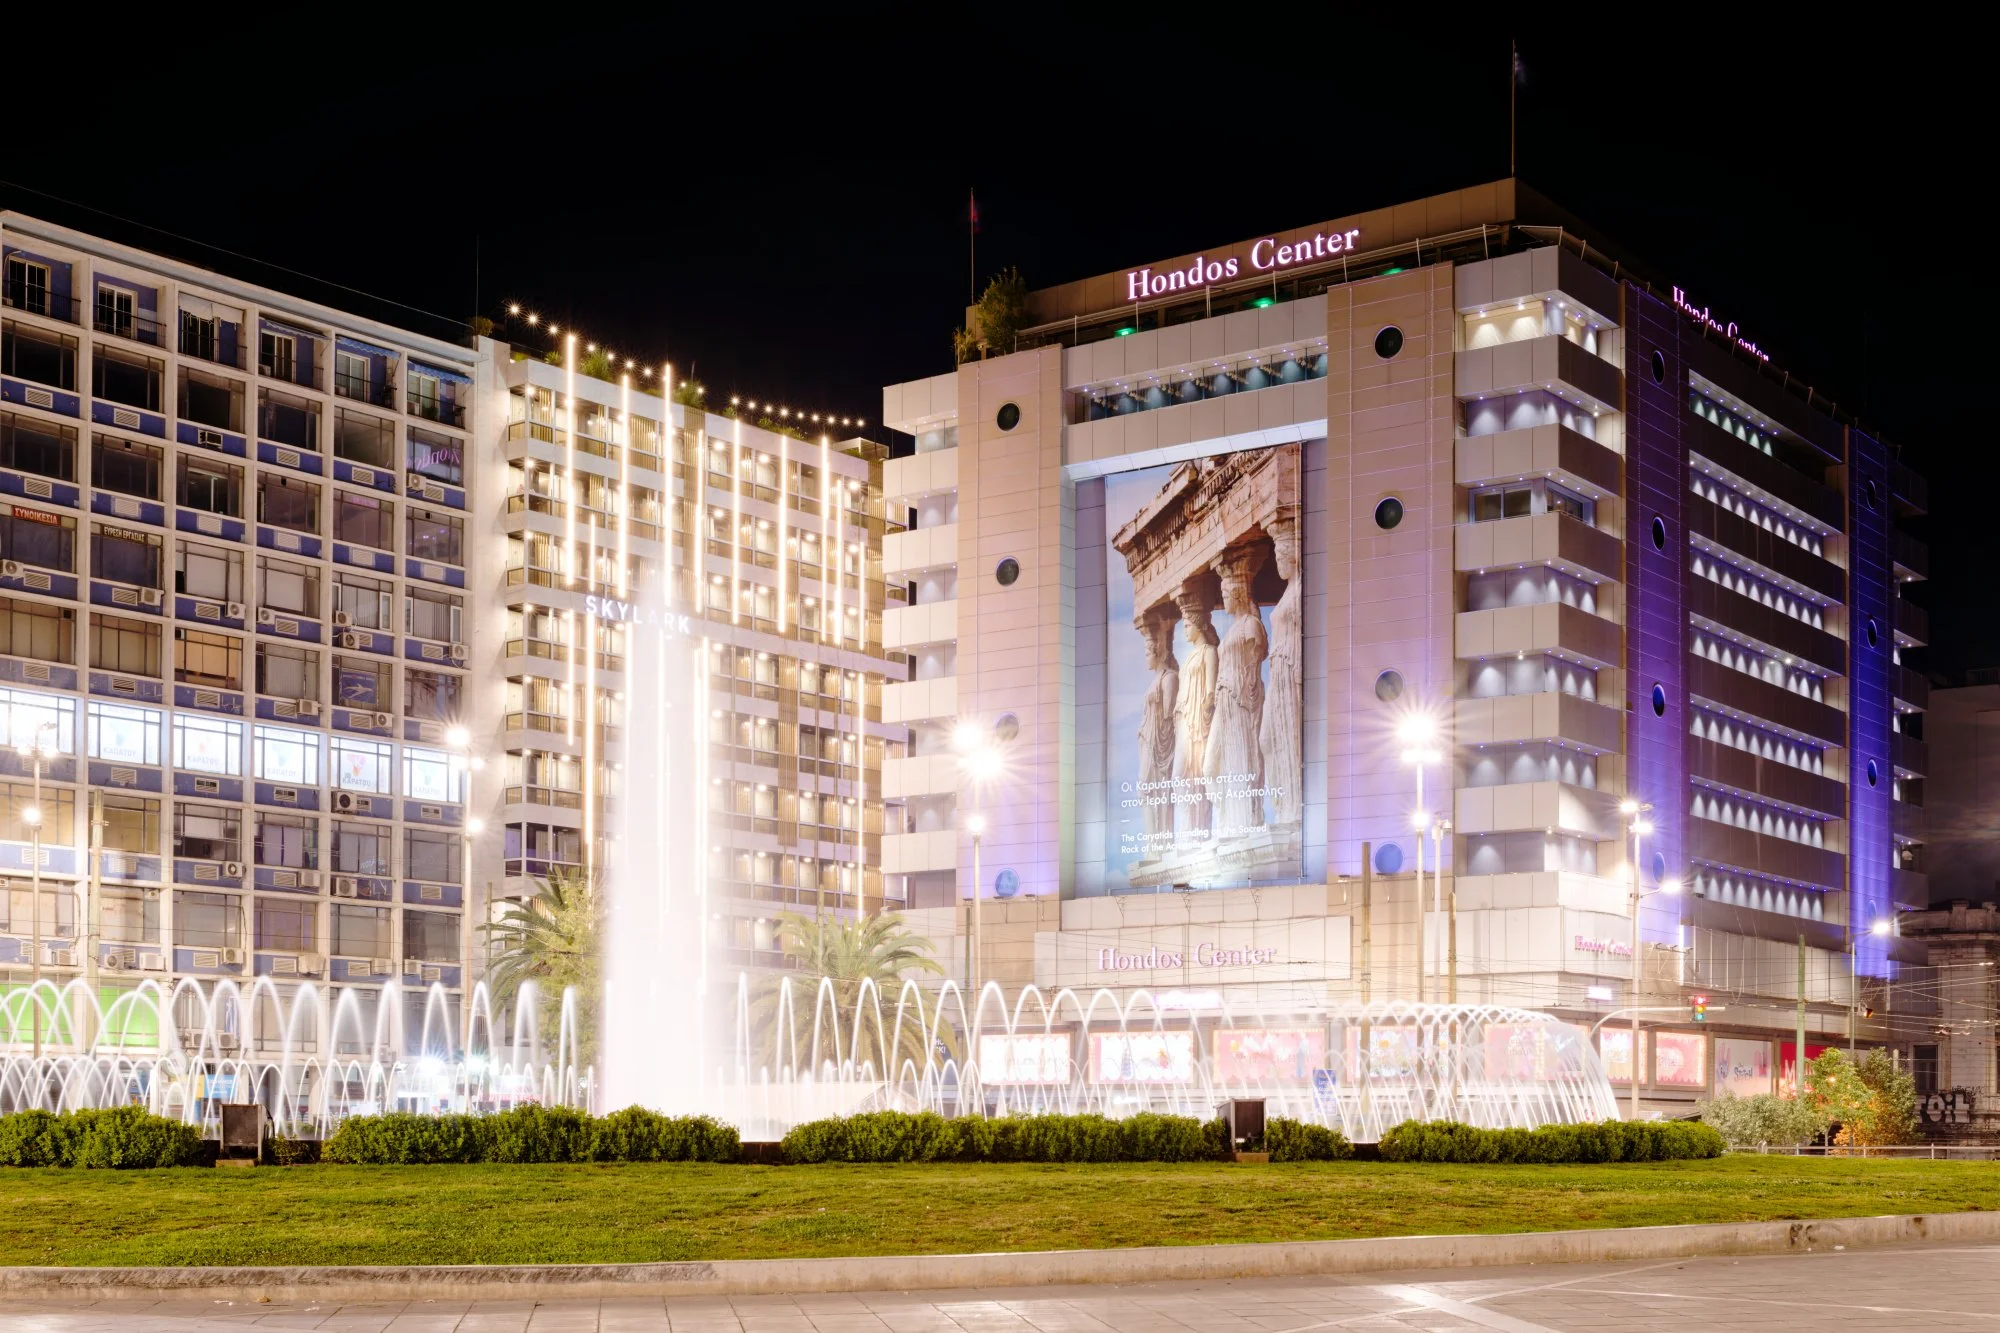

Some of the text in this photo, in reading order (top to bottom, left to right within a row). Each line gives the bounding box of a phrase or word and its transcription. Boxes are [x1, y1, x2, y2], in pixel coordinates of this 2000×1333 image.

[1127, 229, 1360, 300] Hondos Center
[14, 507, 58, 524] ΣΥΝΟΙΚΕΣΙΑ
[103, 526, 145, 542] ΕΥΡΕΣΗ ΕΡΓΑΣΙΑΣ
[585, 595, 690, 634] SKYLARK
[1121, 772, 1256, 795] Οι Καρυάτιδες που στέκουν
[1121, 797, 1143, 808] στον
[1146, 795, 1168, 808] Ιερό
[1171, 793, 1202, 806] Βράχο
[1205, 791, 1223, 801] της
[1121, 834, 1135, 842] The
[1137, 831, 1173, 842] Caryatids
[1176, 827, 1208, 838] standing
[1239, 824, 1267, 833] Sacred
[1121, 845, 1139, 854] Rock
[1141, 844, 1149, 853] of
[1151, 842, 1164, 851] the
[1098, 943, 1277, 971] Hondos Center
